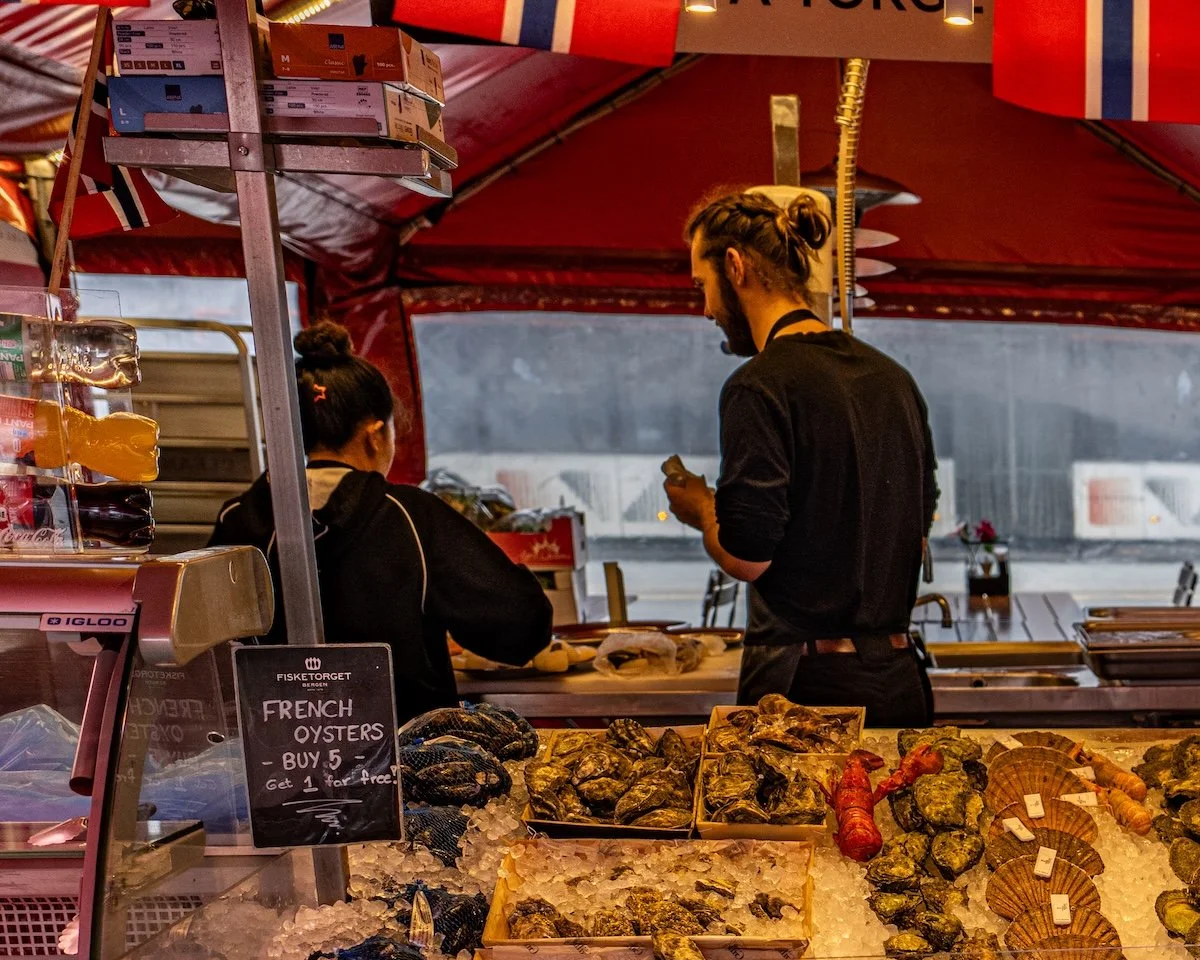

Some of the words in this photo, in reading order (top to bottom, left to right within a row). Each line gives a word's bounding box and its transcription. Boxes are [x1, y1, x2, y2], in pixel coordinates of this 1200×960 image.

[281, 55, 290, 63] M
[0, 353, 24, 362] PAN
[65, 617, 128, 627] IGLOO
[276, 672, 352, 682] FISKETORGET
[262, 698, 353, 722] FRENCH
[294, 723, 384, 744] OYSTERS
[281, 751, 320, 770] BUY
[328, 749, 343, 770] 5
[265, 778, 293, 791] Get
